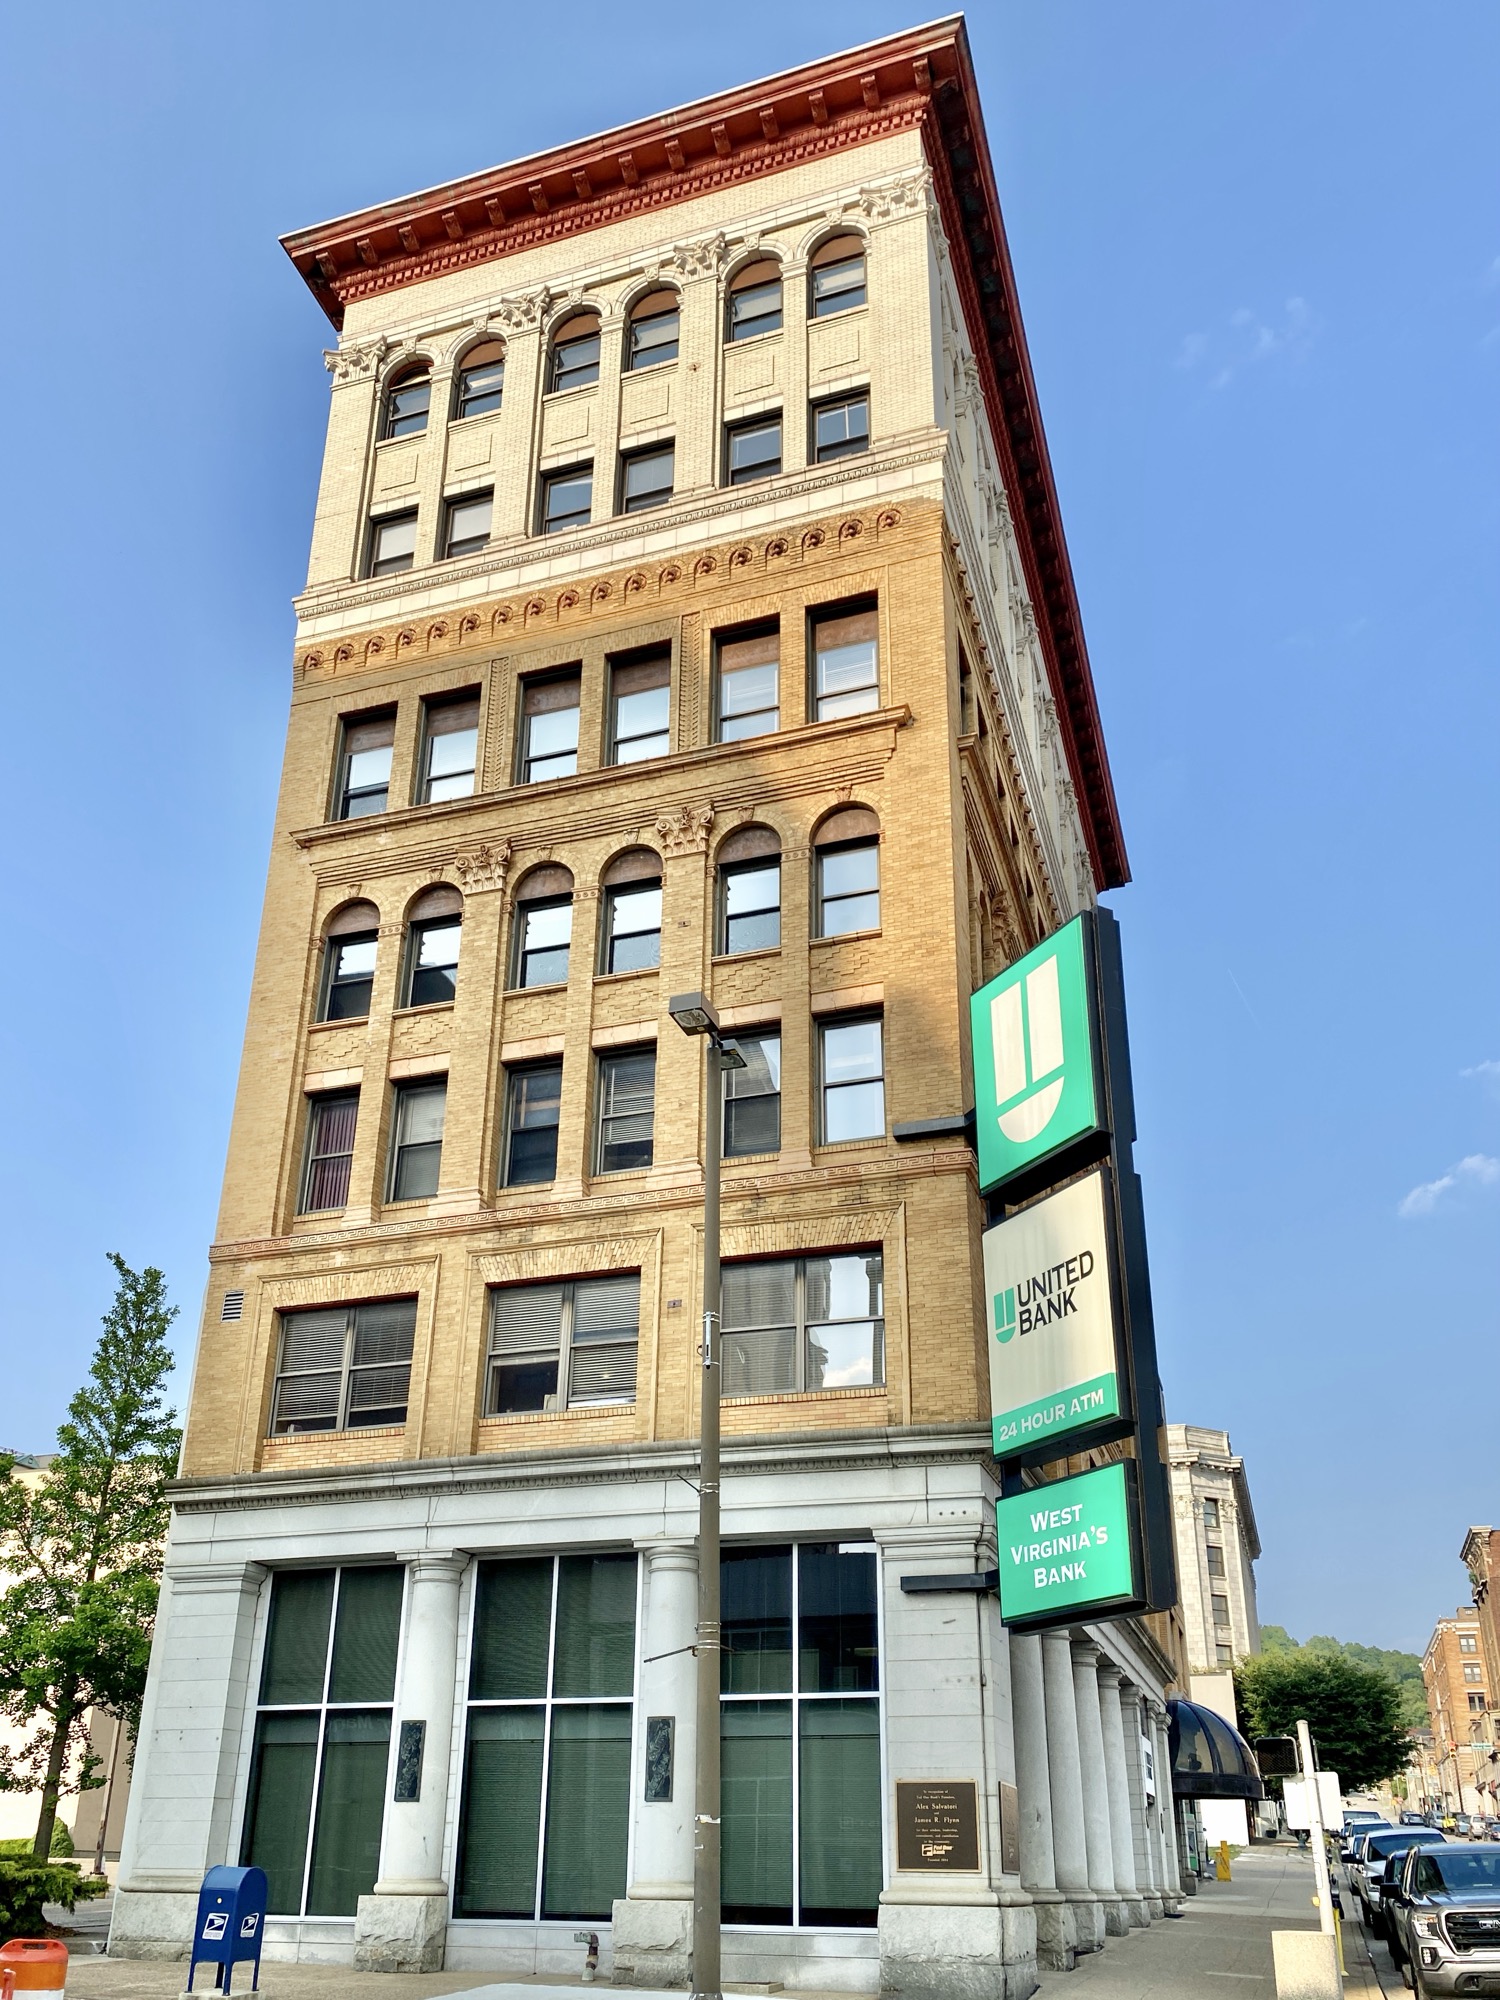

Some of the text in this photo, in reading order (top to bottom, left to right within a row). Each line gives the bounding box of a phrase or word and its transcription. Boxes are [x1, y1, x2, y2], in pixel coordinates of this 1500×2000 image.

[1017, 1250, 1094, 1307] UNITED
[1019, 1286, 1078, 1336] BANK
[1000, 1388, 1105, 1441] 24 HOUR ATM
[1030, 1504, 1083, 1533] WEST
[1010, 1525, 1109, 1565] VIRGINIA'S
[1033, 1560, 1087, 1589] BANK
